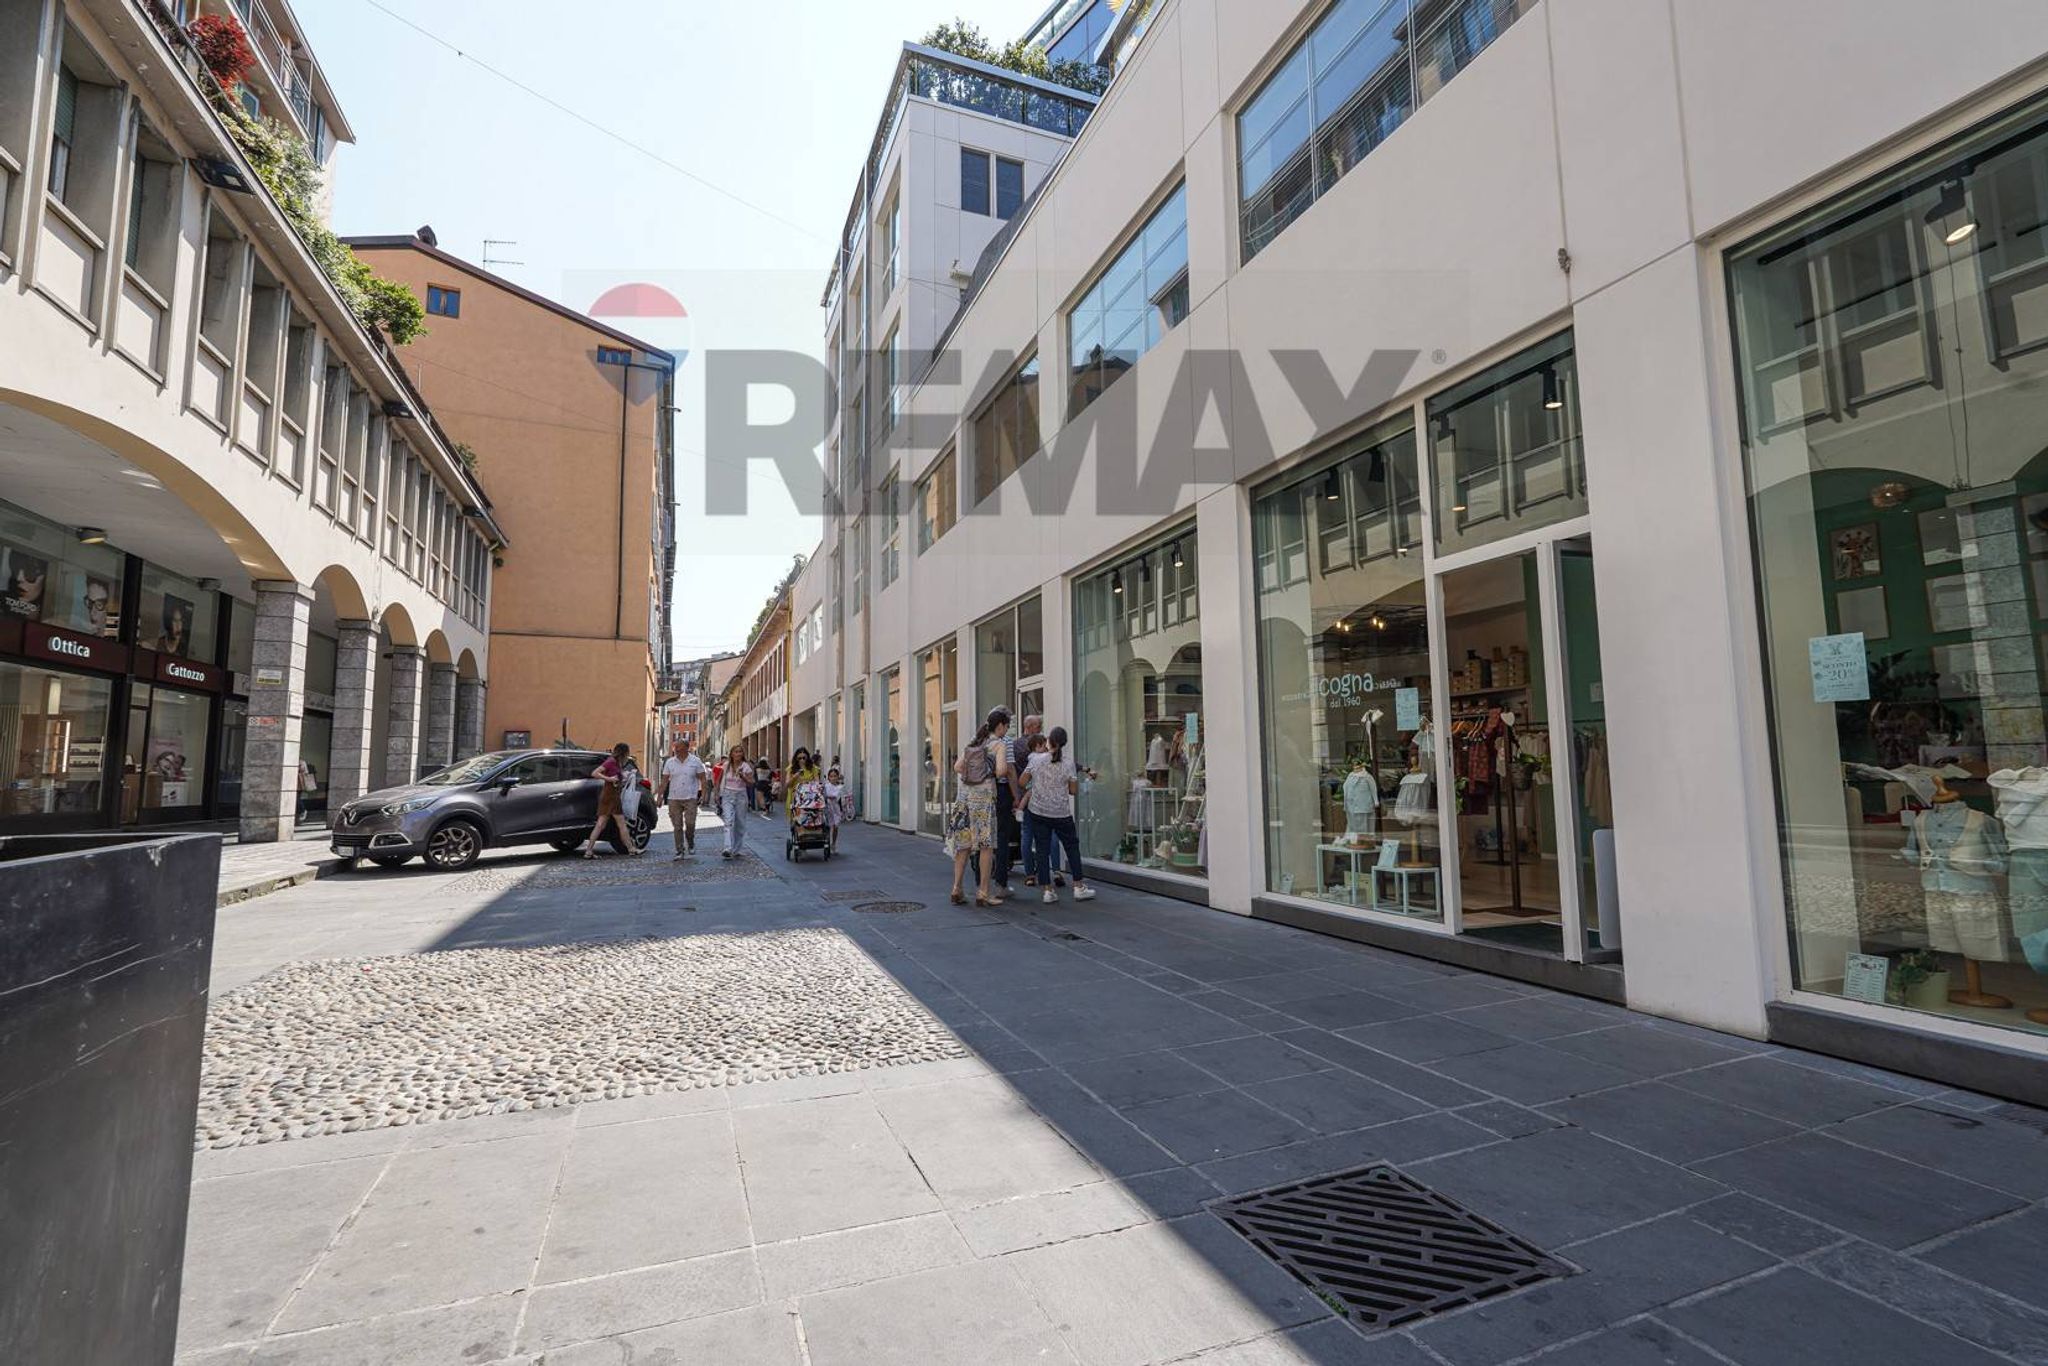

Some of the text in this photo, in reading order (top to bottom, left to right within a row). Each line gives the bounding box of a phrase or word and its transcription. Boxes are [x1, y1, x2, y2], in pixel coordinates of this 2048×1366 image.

[51, 636, 206, 682] Ottica Cattozzo
[1343, 695, 1361, 707] 1960
